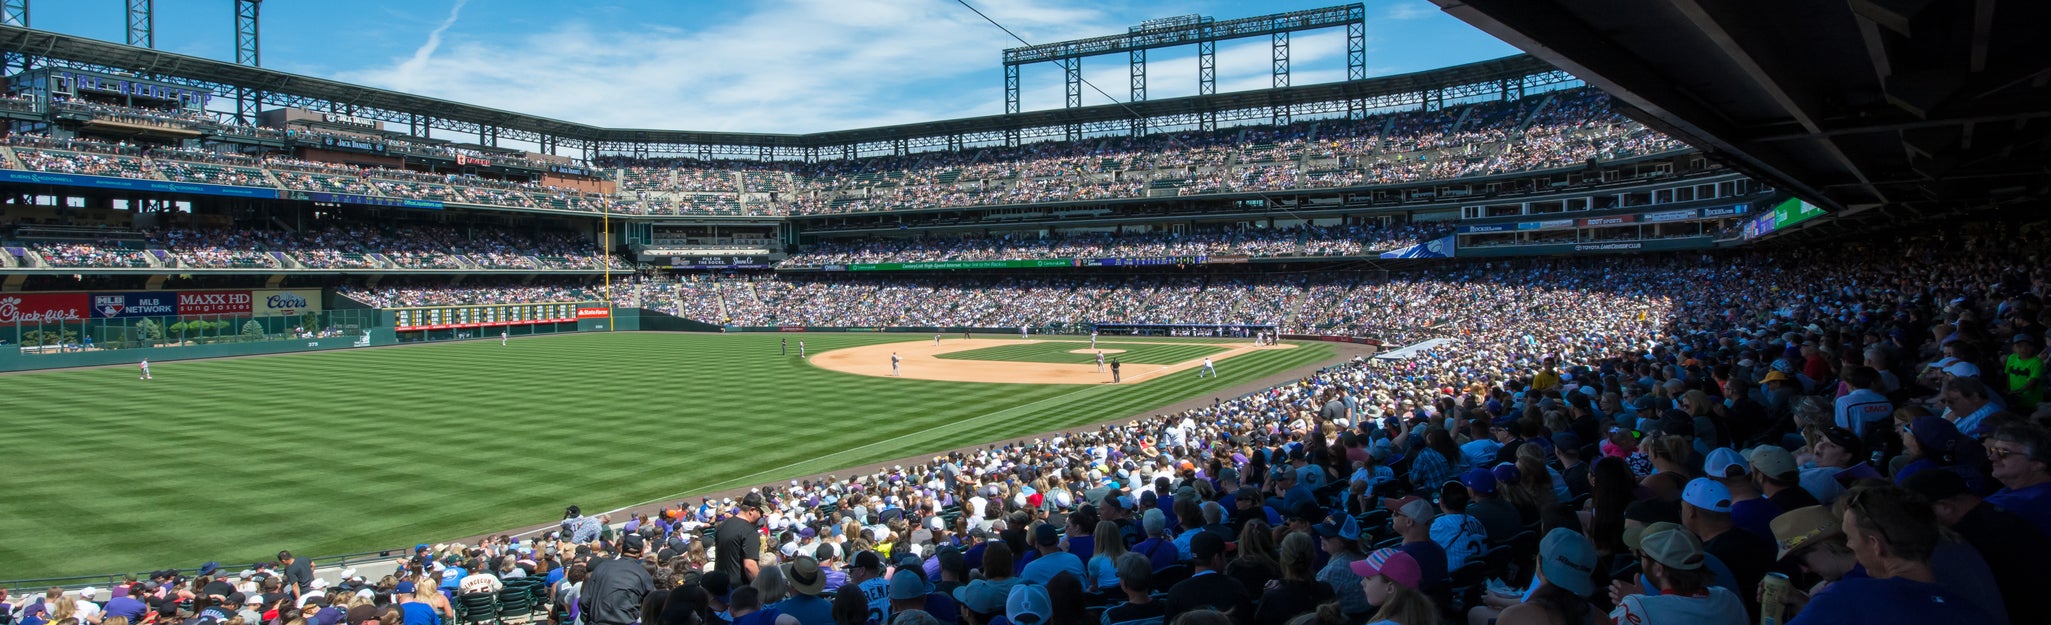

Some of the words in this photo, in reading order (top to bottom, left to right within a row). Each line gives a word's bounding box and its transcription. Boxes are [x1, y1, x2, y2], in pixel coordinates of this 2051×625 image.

[62, 72, 103, 91] THE
[119, 80, 212, 105] ROOFTOP
[139, 298, 160, 306] MLB
[180, 295, 227, 305] MAXX
[229, 293, 250, 304] HD
[266, 294, 307, 309] Coors
[125, 305, 172, 313] NETWORK
[180, 304, 250, 312] sunglasses
[464, 578, 492, 590] LINCECUM
